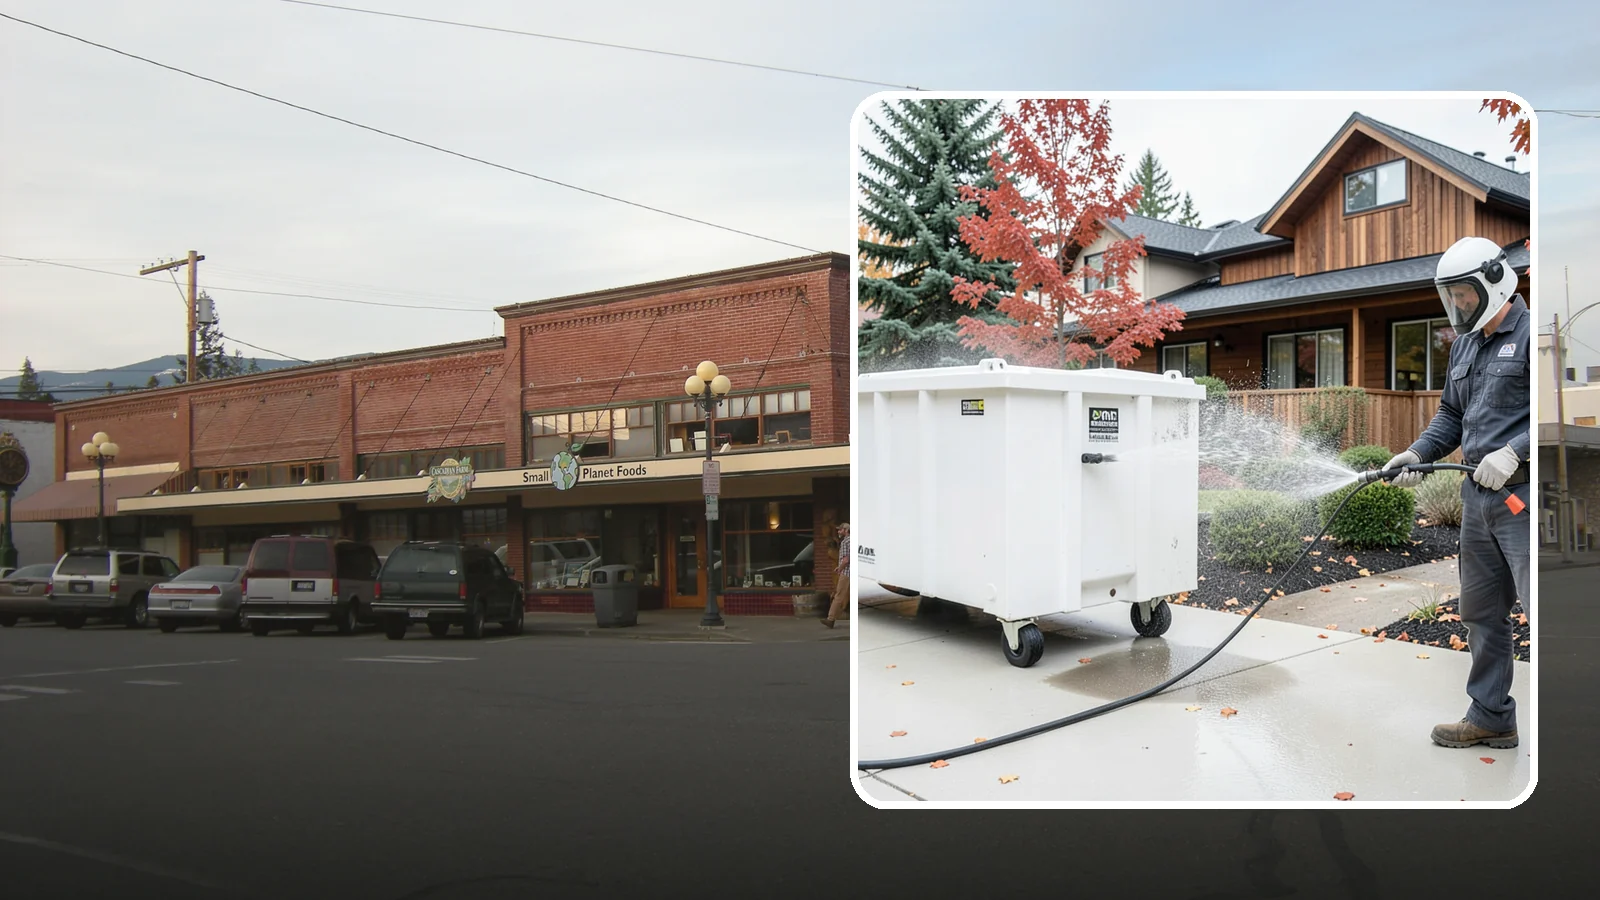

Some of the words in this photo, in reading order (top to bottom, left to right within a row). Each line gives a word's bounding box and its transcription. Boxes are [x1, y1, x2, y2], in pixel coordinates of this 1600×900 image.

[523, 470, 549, 483] Small
[582, 467, 614, 479] Planet
[616, 464, 647, 477] Foods
